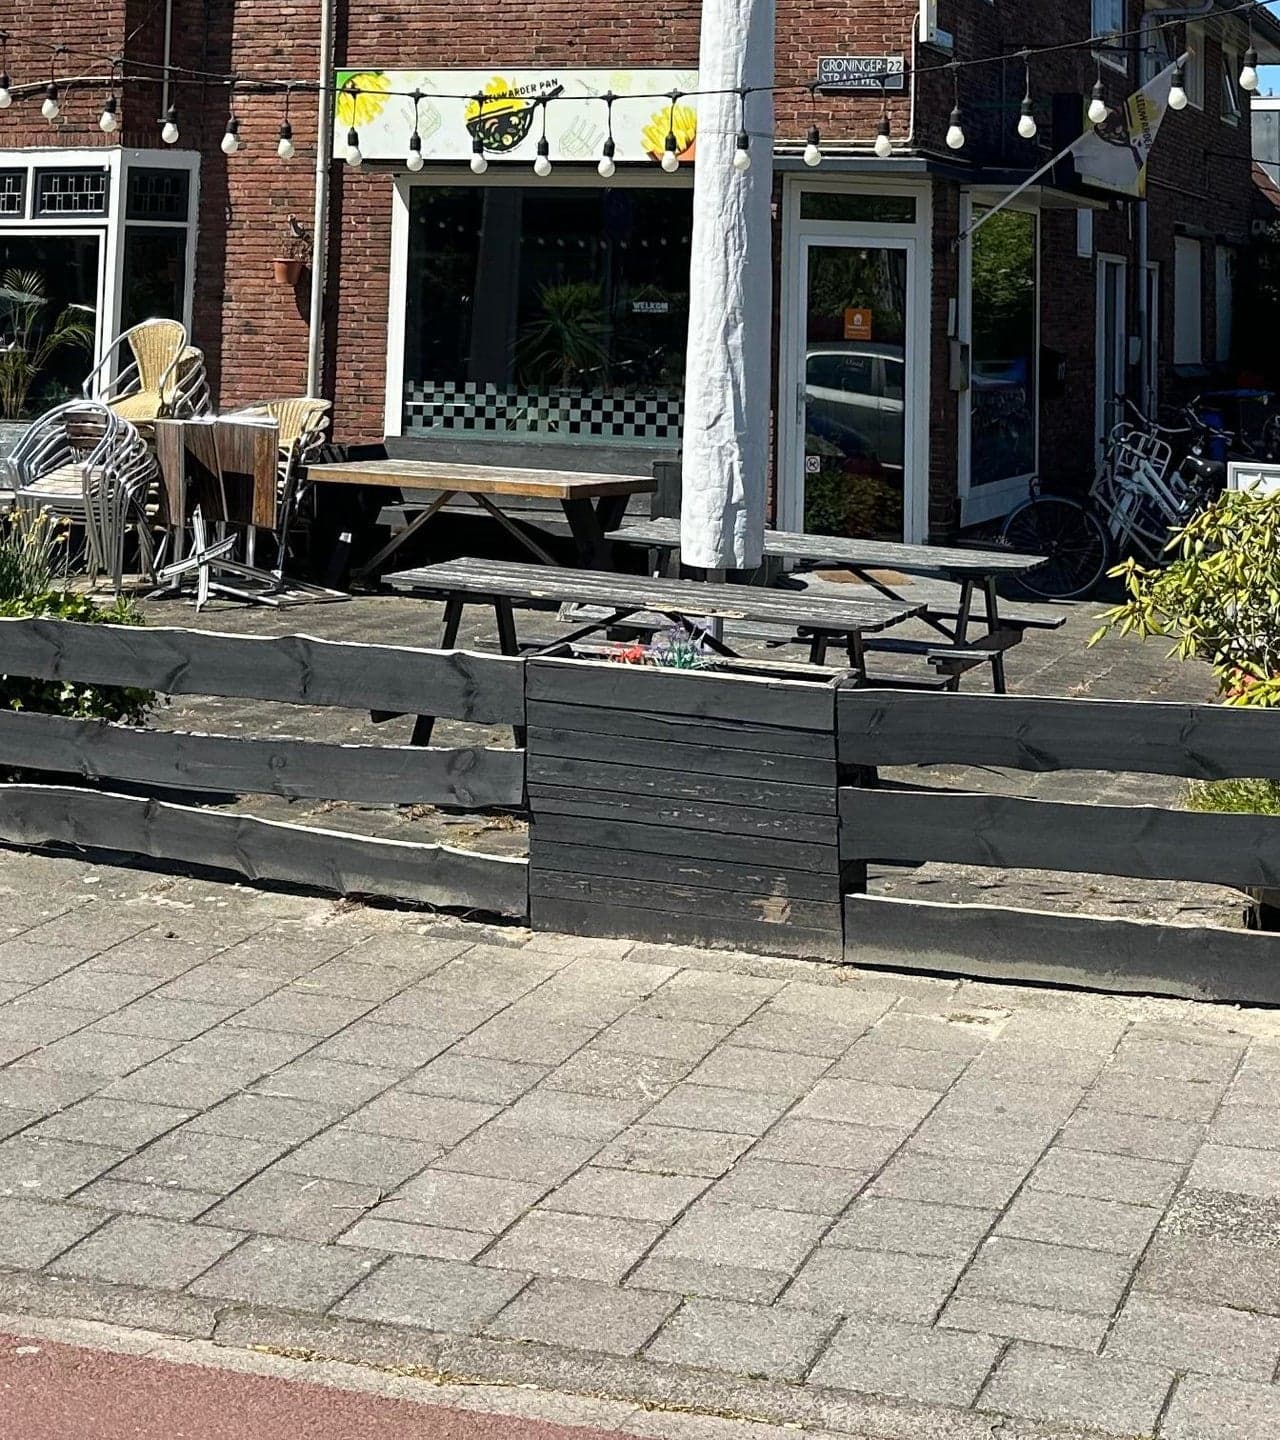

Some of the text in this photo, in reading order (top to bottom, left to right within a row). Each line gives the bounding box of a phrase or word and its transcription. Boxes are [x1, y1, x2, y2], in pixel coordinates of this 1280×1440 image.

[821, 59, 886, 72] GRONINGER-
[888, 61, 902, 72] 22
[479, 78, 559, 104] EEUWARDER PAN
